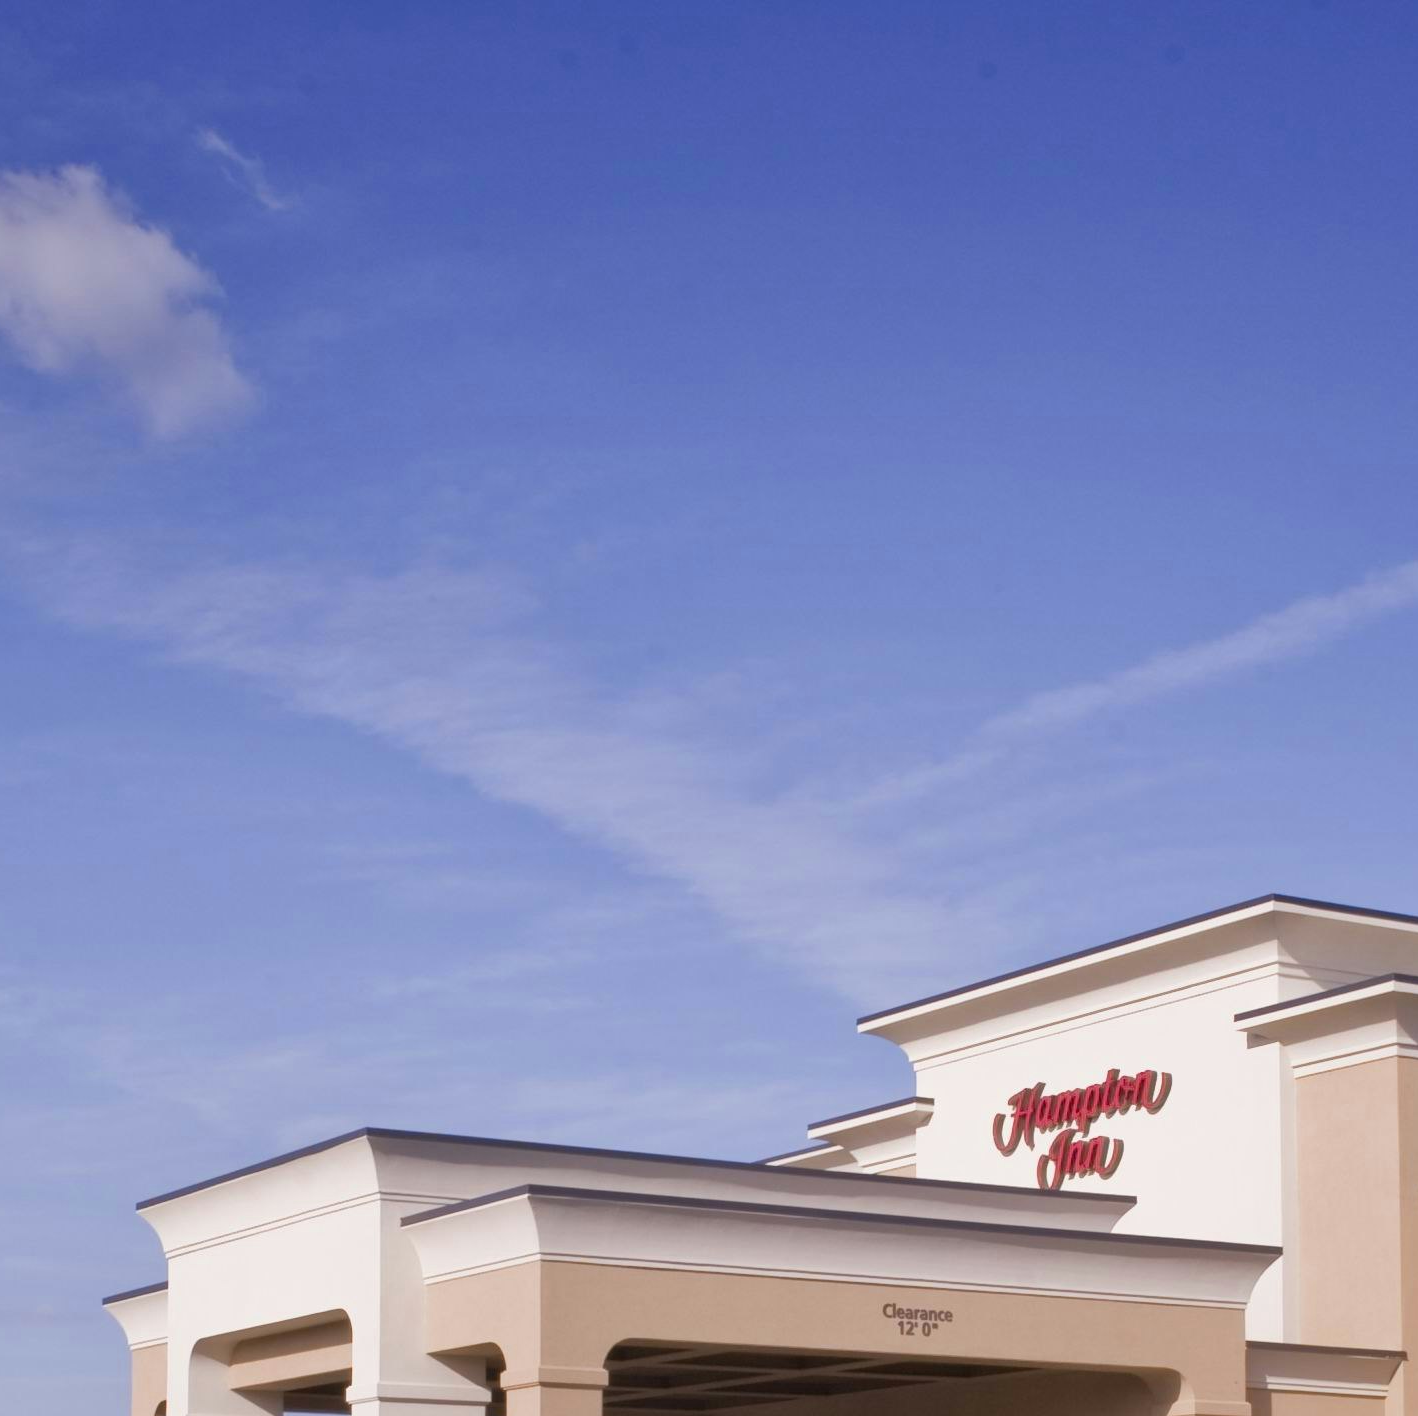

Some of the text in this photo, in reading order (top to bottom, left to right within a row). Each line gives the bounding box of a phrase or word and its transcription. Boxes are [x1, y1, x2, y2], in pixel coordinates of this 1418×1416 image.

[992, 1068, 1172, 1157] Hampton
[1037, 1128, 1124, 1190] Inn
[882, 1303, 953, 1322] Clearance
